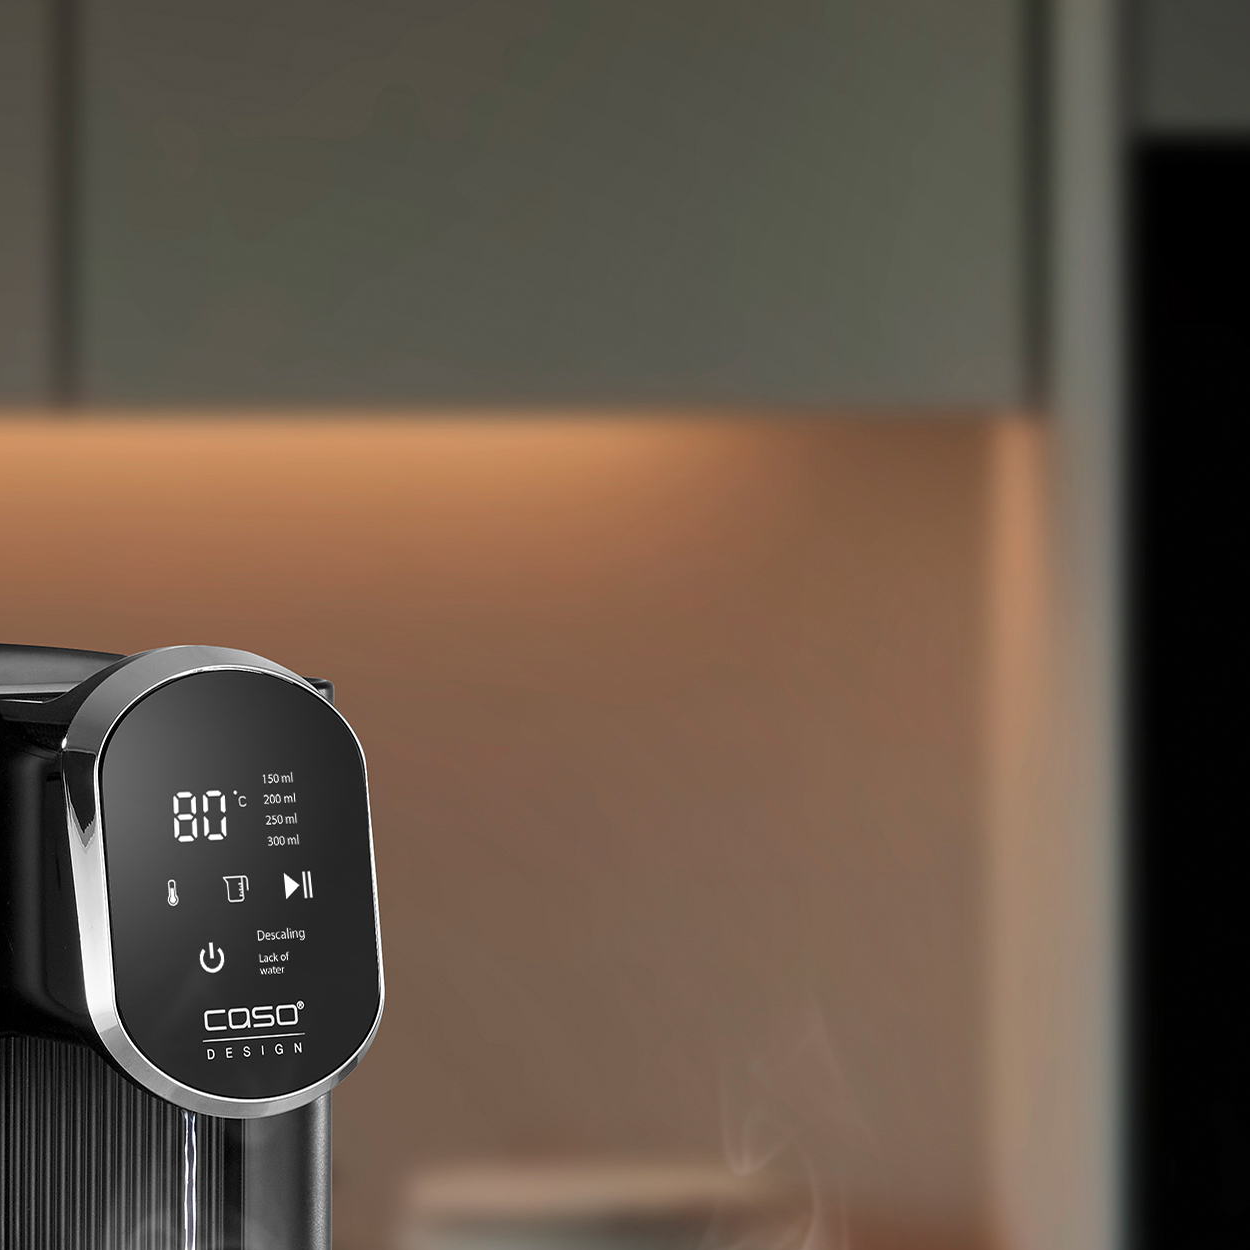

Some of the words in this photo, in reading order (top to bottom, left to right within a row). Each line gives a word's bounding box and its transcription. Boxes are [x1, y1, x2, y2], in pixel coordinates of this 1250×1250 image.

[262, 773, 280, 784] 150
[281, 771, 294, 783] ml
[263, 793, 282, 805] 200
[283, 792, 297, 804] ml
[172, 789, 228, 843] 80
[265, 814, 284, 826] 250
[285, 812, 298, 825] ml
[267, 835, 286, 847] 300
[287, 834, 300, 845] ml
[256, 927, 306, 941] Descaling
[258, 952, 279, 963] Lack
[280, 951, 289, 962] of
[259, 966, 285, 975] water
[206, 1042, 303, 1060] DESIGN
